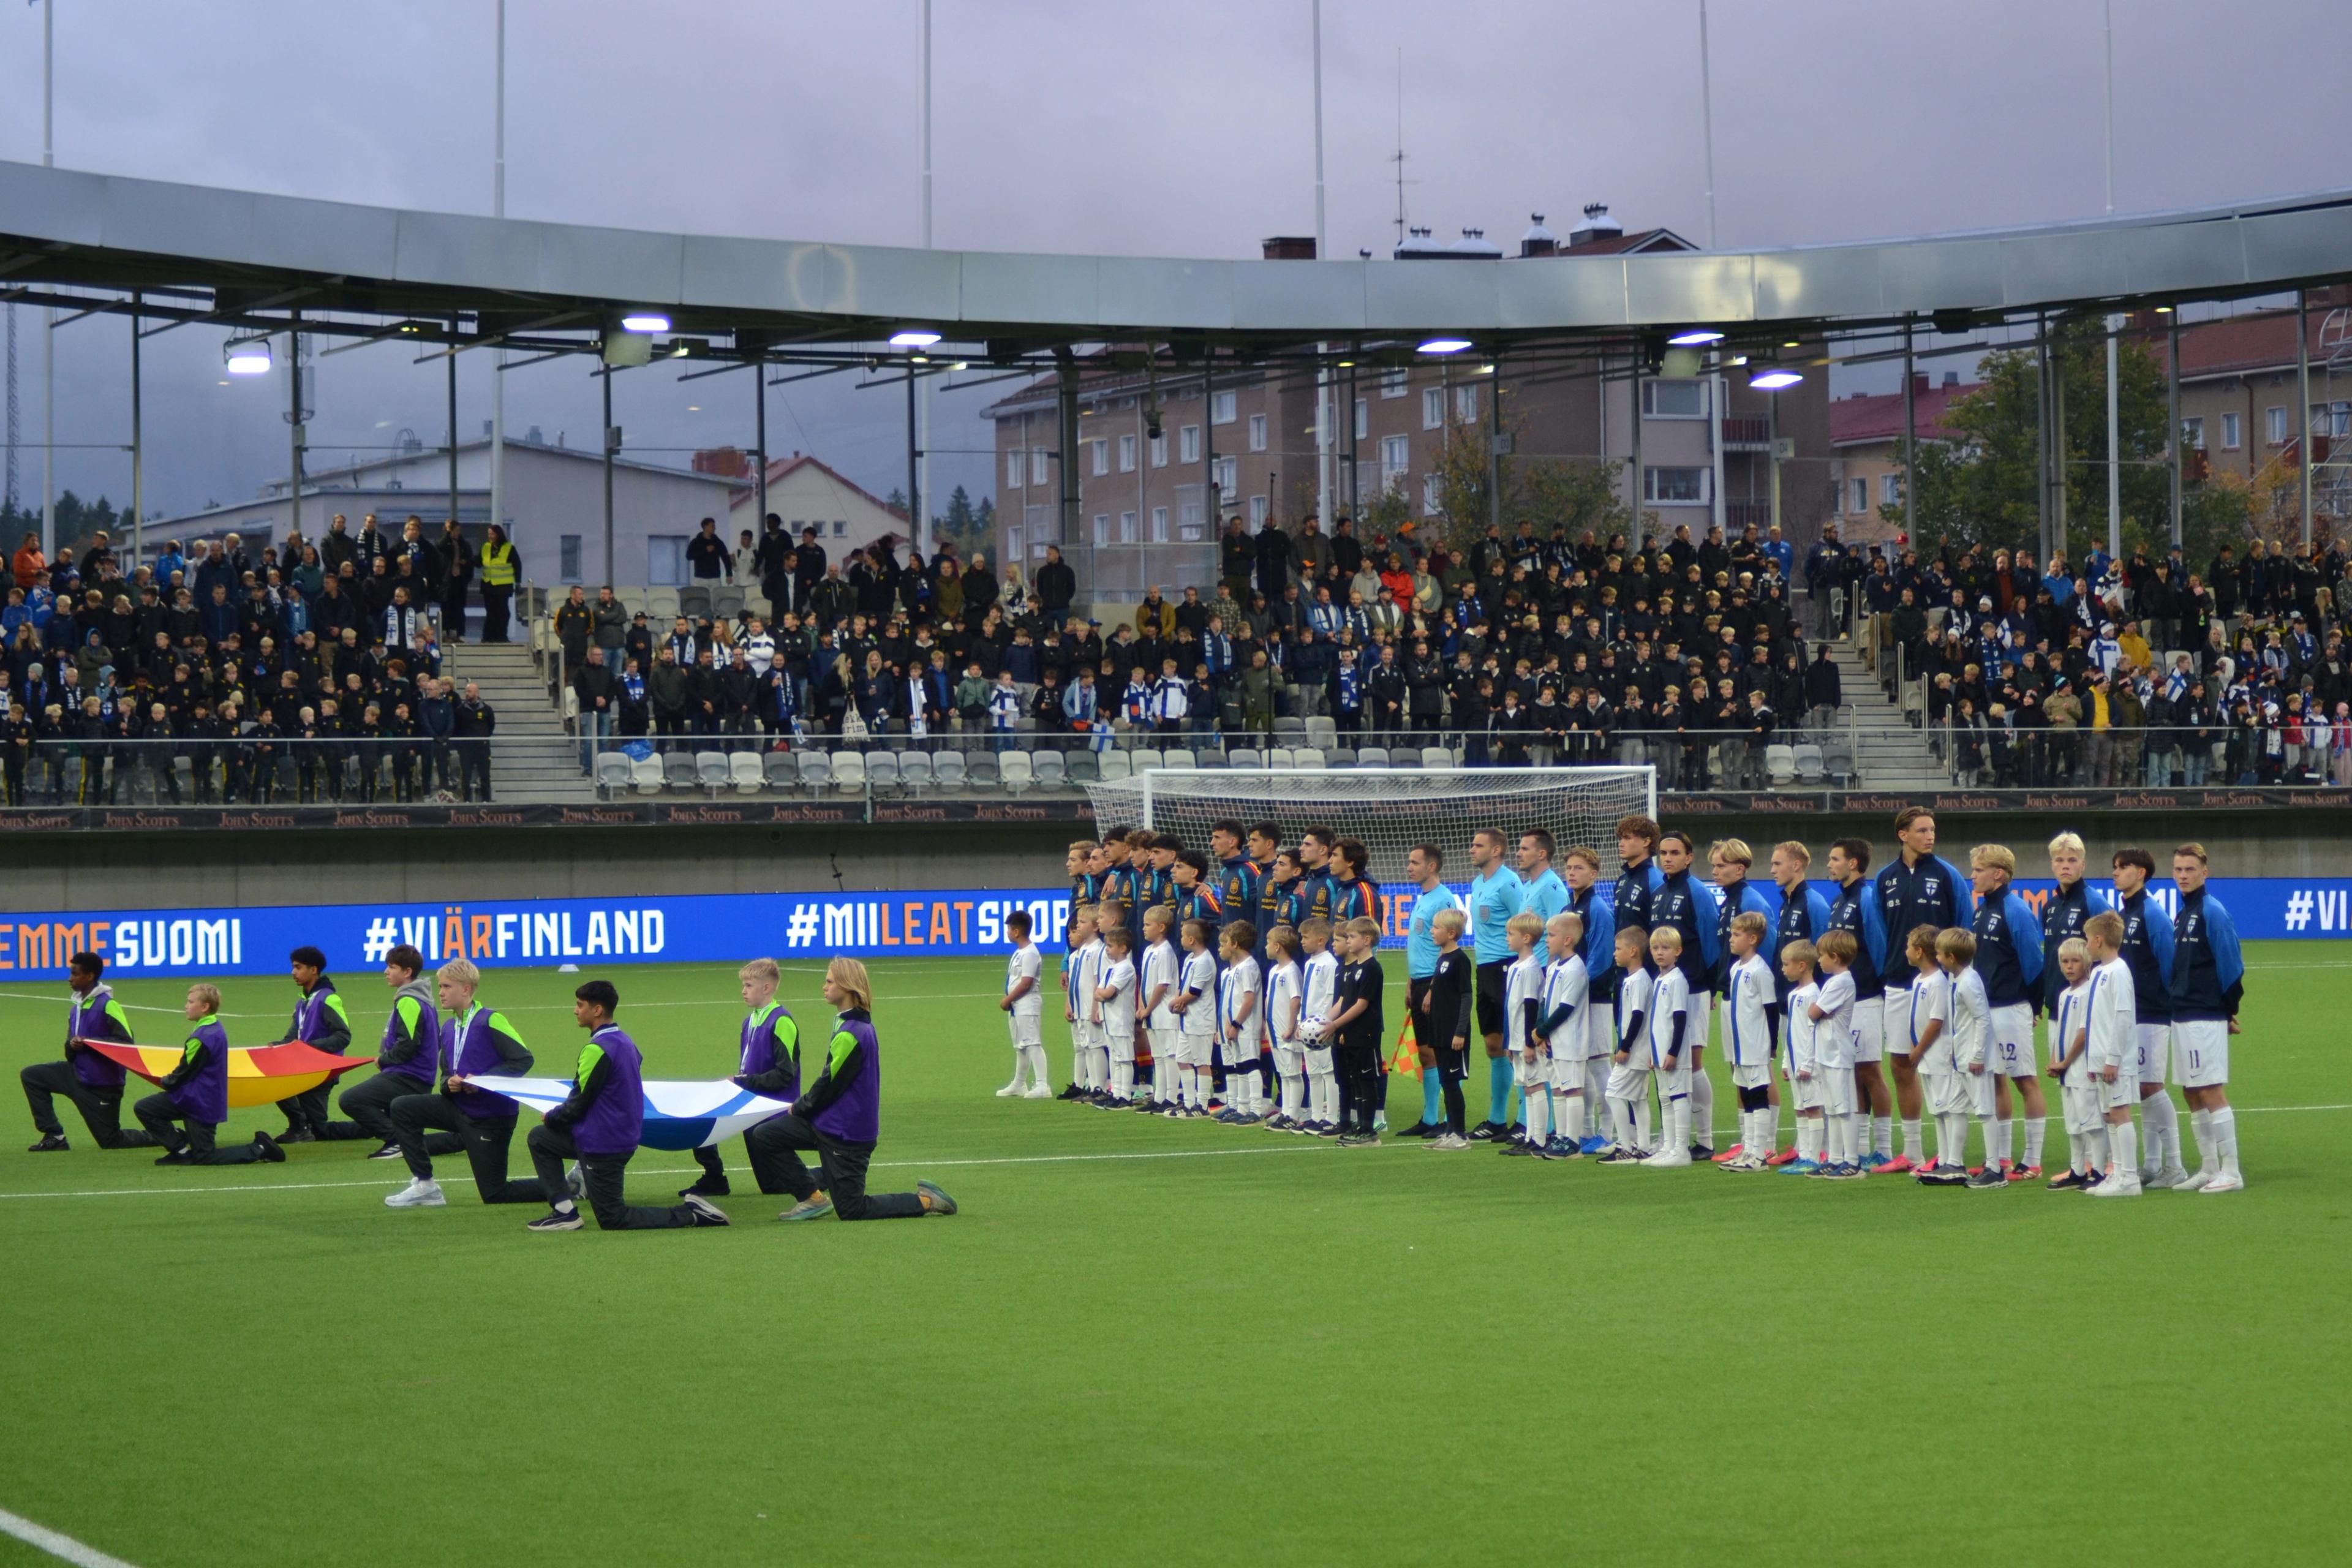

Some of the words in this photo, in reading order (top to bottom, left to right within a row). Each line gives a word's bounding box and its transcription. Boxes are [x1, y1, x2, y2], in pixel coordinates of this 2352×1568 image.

[2285, 890, 2352, 930] #VI
[363, 907, 665, 962] #VIÄRFINLAND
[2189, 1049, 2199, 1069] 11
